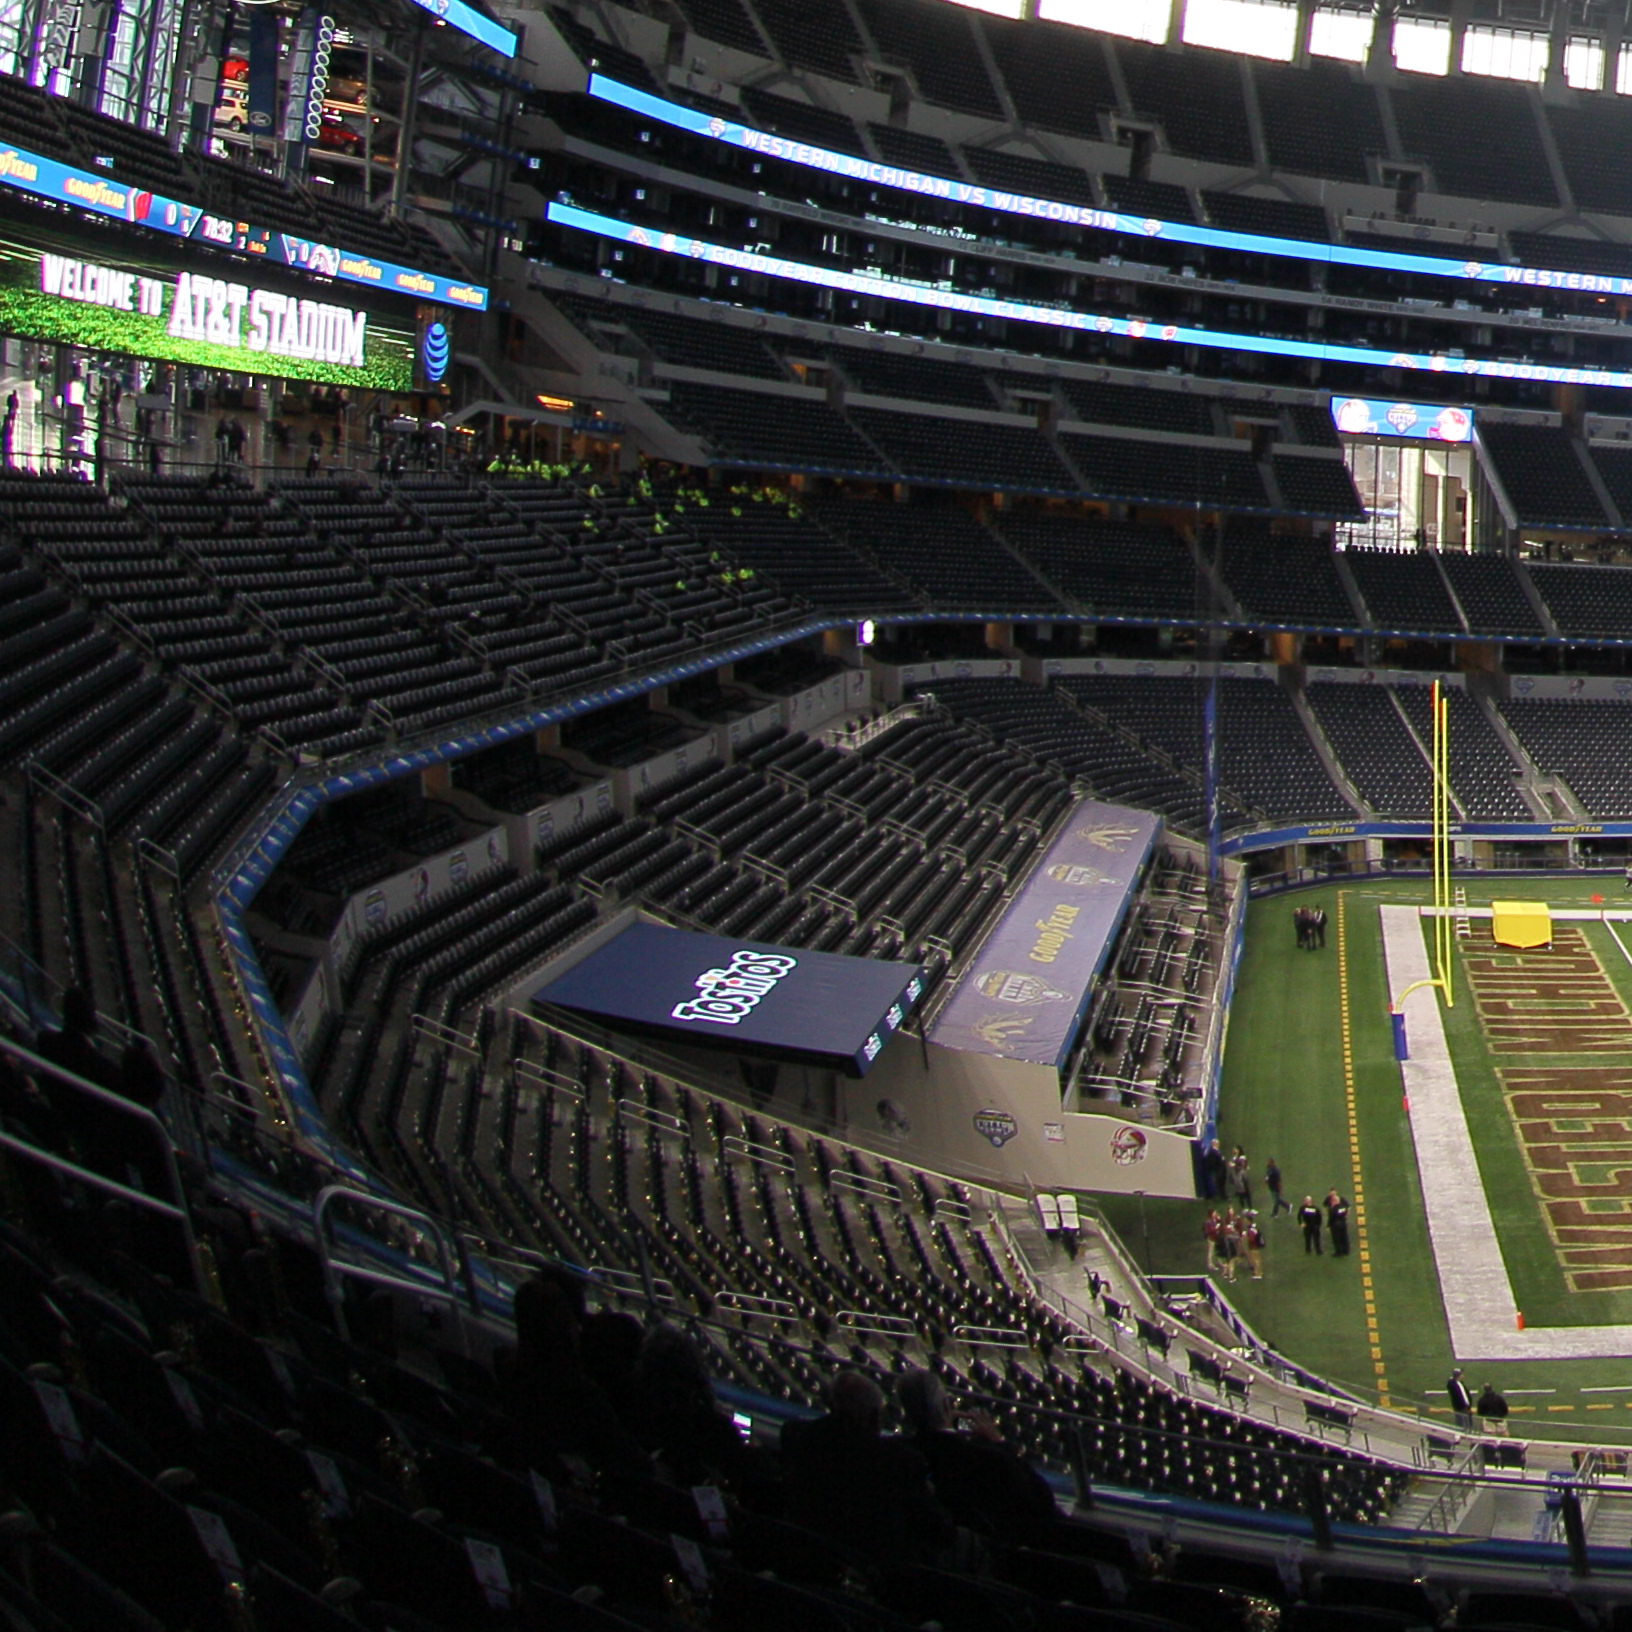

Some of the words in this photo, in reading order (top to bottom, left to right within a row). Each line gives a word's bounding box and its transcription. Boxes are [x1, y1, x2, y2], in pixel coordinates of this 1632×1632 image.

[743, 128, 840, 172] WESTERN
[847, 155, 950, 197] MICHIGAN
[957, 182, 985, 206] VS
[992, 190, 1117, 230] WISCONSIN
[42, 253, 134, 311] WELCOME
[139, 277, 163, 316] TO
[168, 271, 249, 347] AT&T
[249, 289, 366, 366] STADIUM
[708, 246, 825, 285] GOODYEAR
[832, 270, 919, 305] COTTON
[926, 288, 985, 314] BOWL
[997, 300, 1086, 331] CLASSIC
[1504, 267, 1613, 293] WESTERN
[1487, 361, 1612, 387] GOODYEAR
[1307, 824, 1356, 837] GOODYEAR
[1551, 824, 1603, 834] GOODYEAR
[1029, 904, 1082, 964] GOODYEAR
